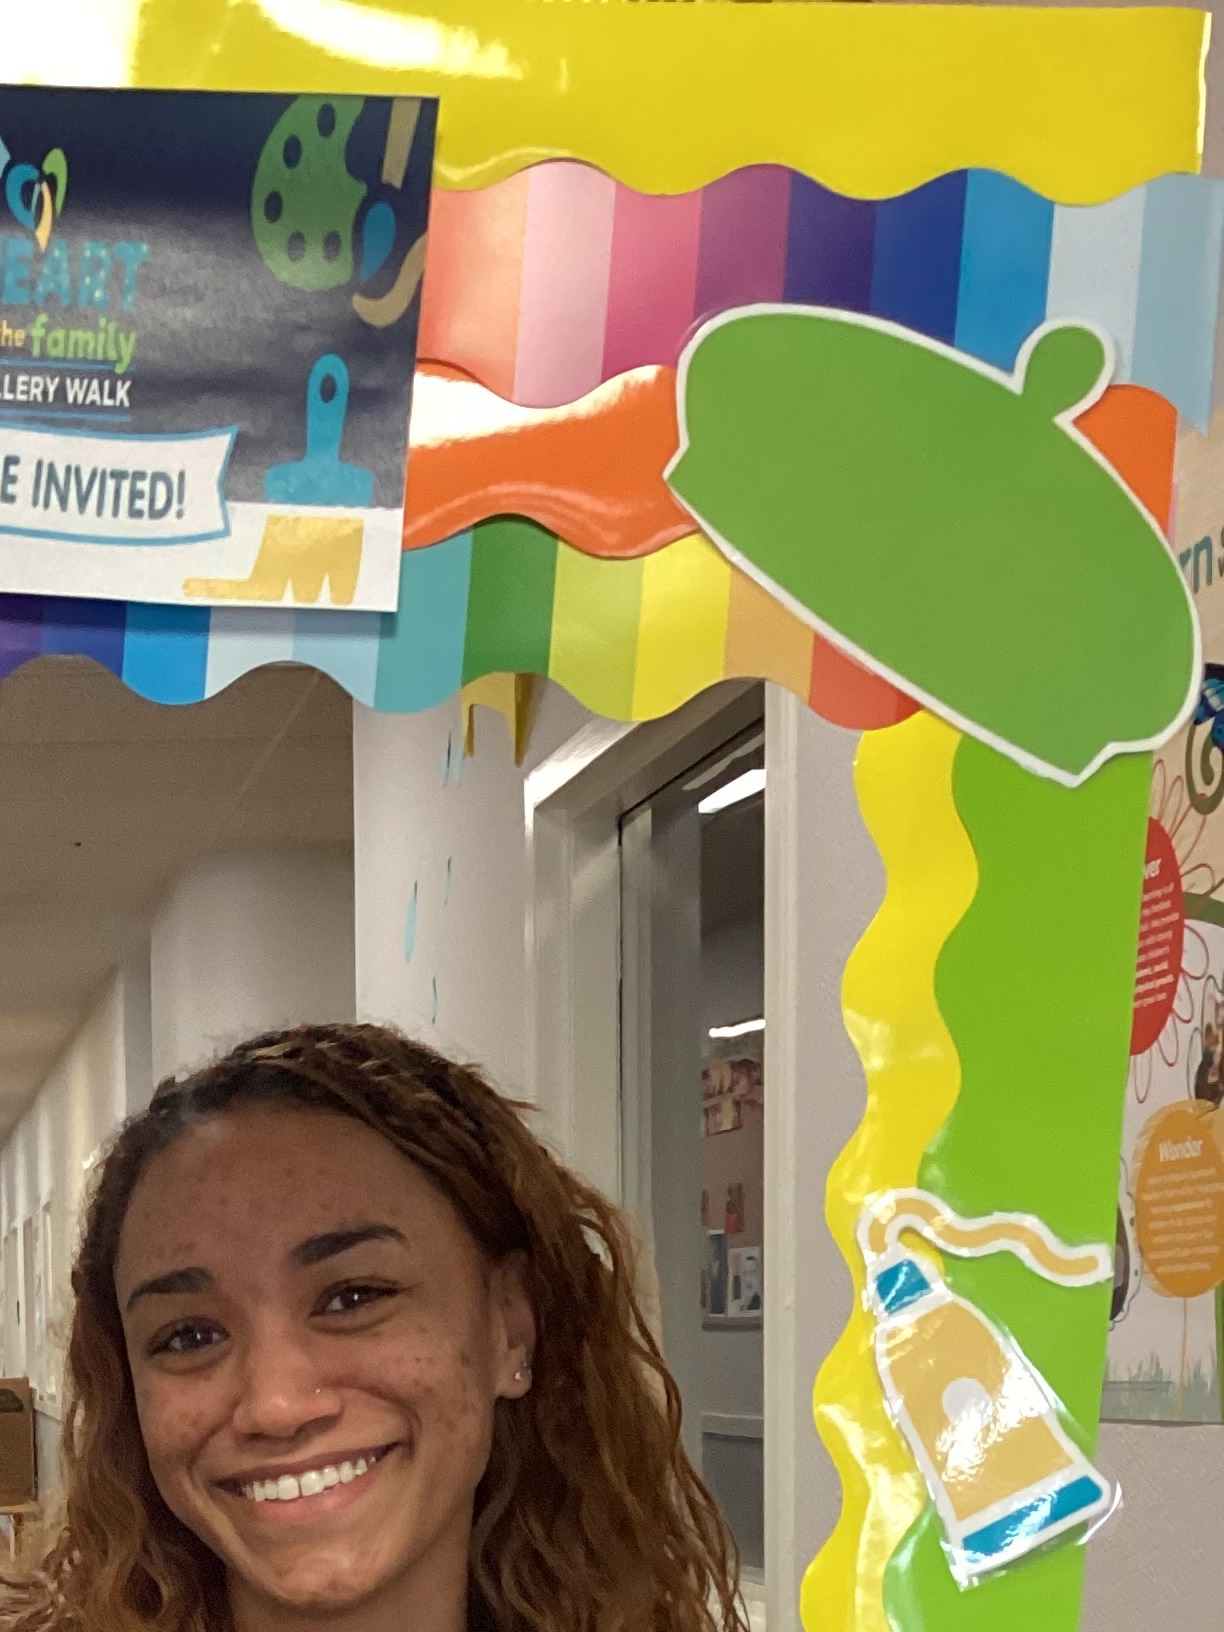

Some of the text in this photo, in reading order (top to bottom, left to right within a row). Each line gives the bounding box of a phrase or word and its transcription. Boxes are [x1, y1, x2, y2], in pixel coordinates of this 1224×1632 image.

[29, 313, 136, 374] family
[66, 377, 131, 408] WALK
[31, 458, 186, 520] INVITED!
